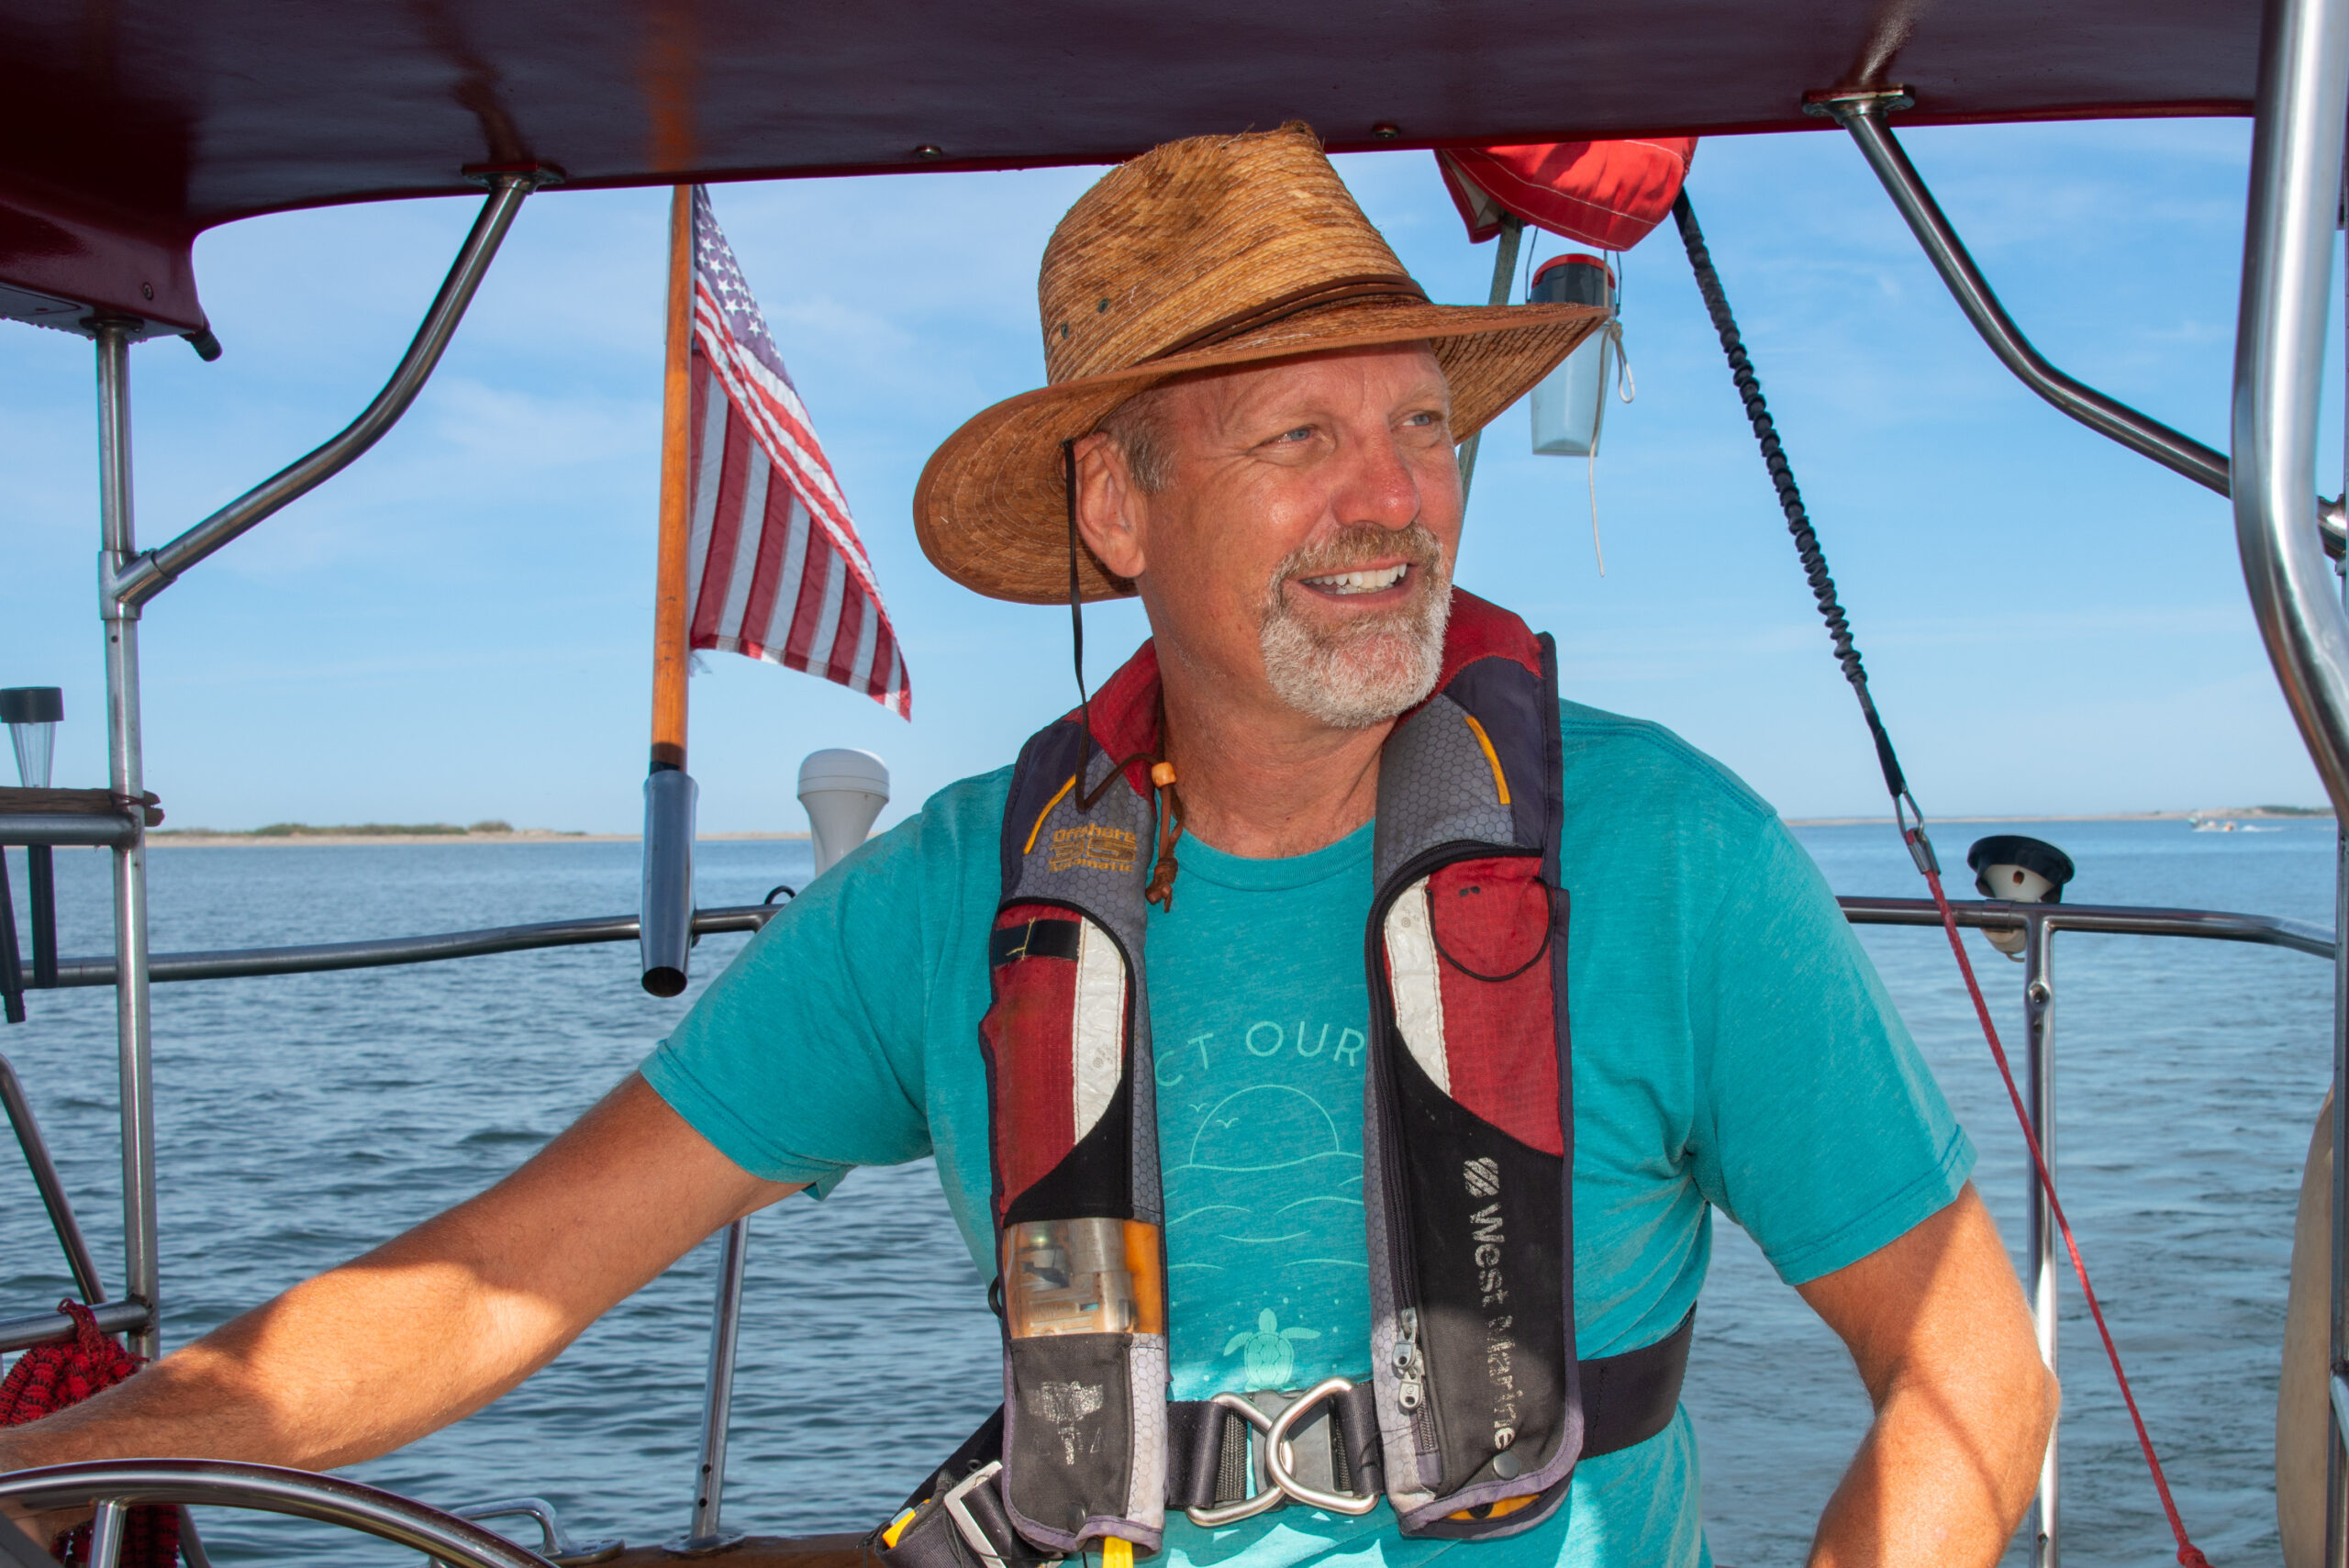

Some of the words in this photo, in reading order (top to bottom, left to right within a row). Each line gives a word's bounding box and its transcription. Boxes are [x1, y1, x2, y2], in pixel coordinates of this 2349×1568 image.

[1052, 822, 1137, 843] Offshore
[1245, 1020, 1366, 1068] OUR
[1469, 1202, 1510, 1307] West
